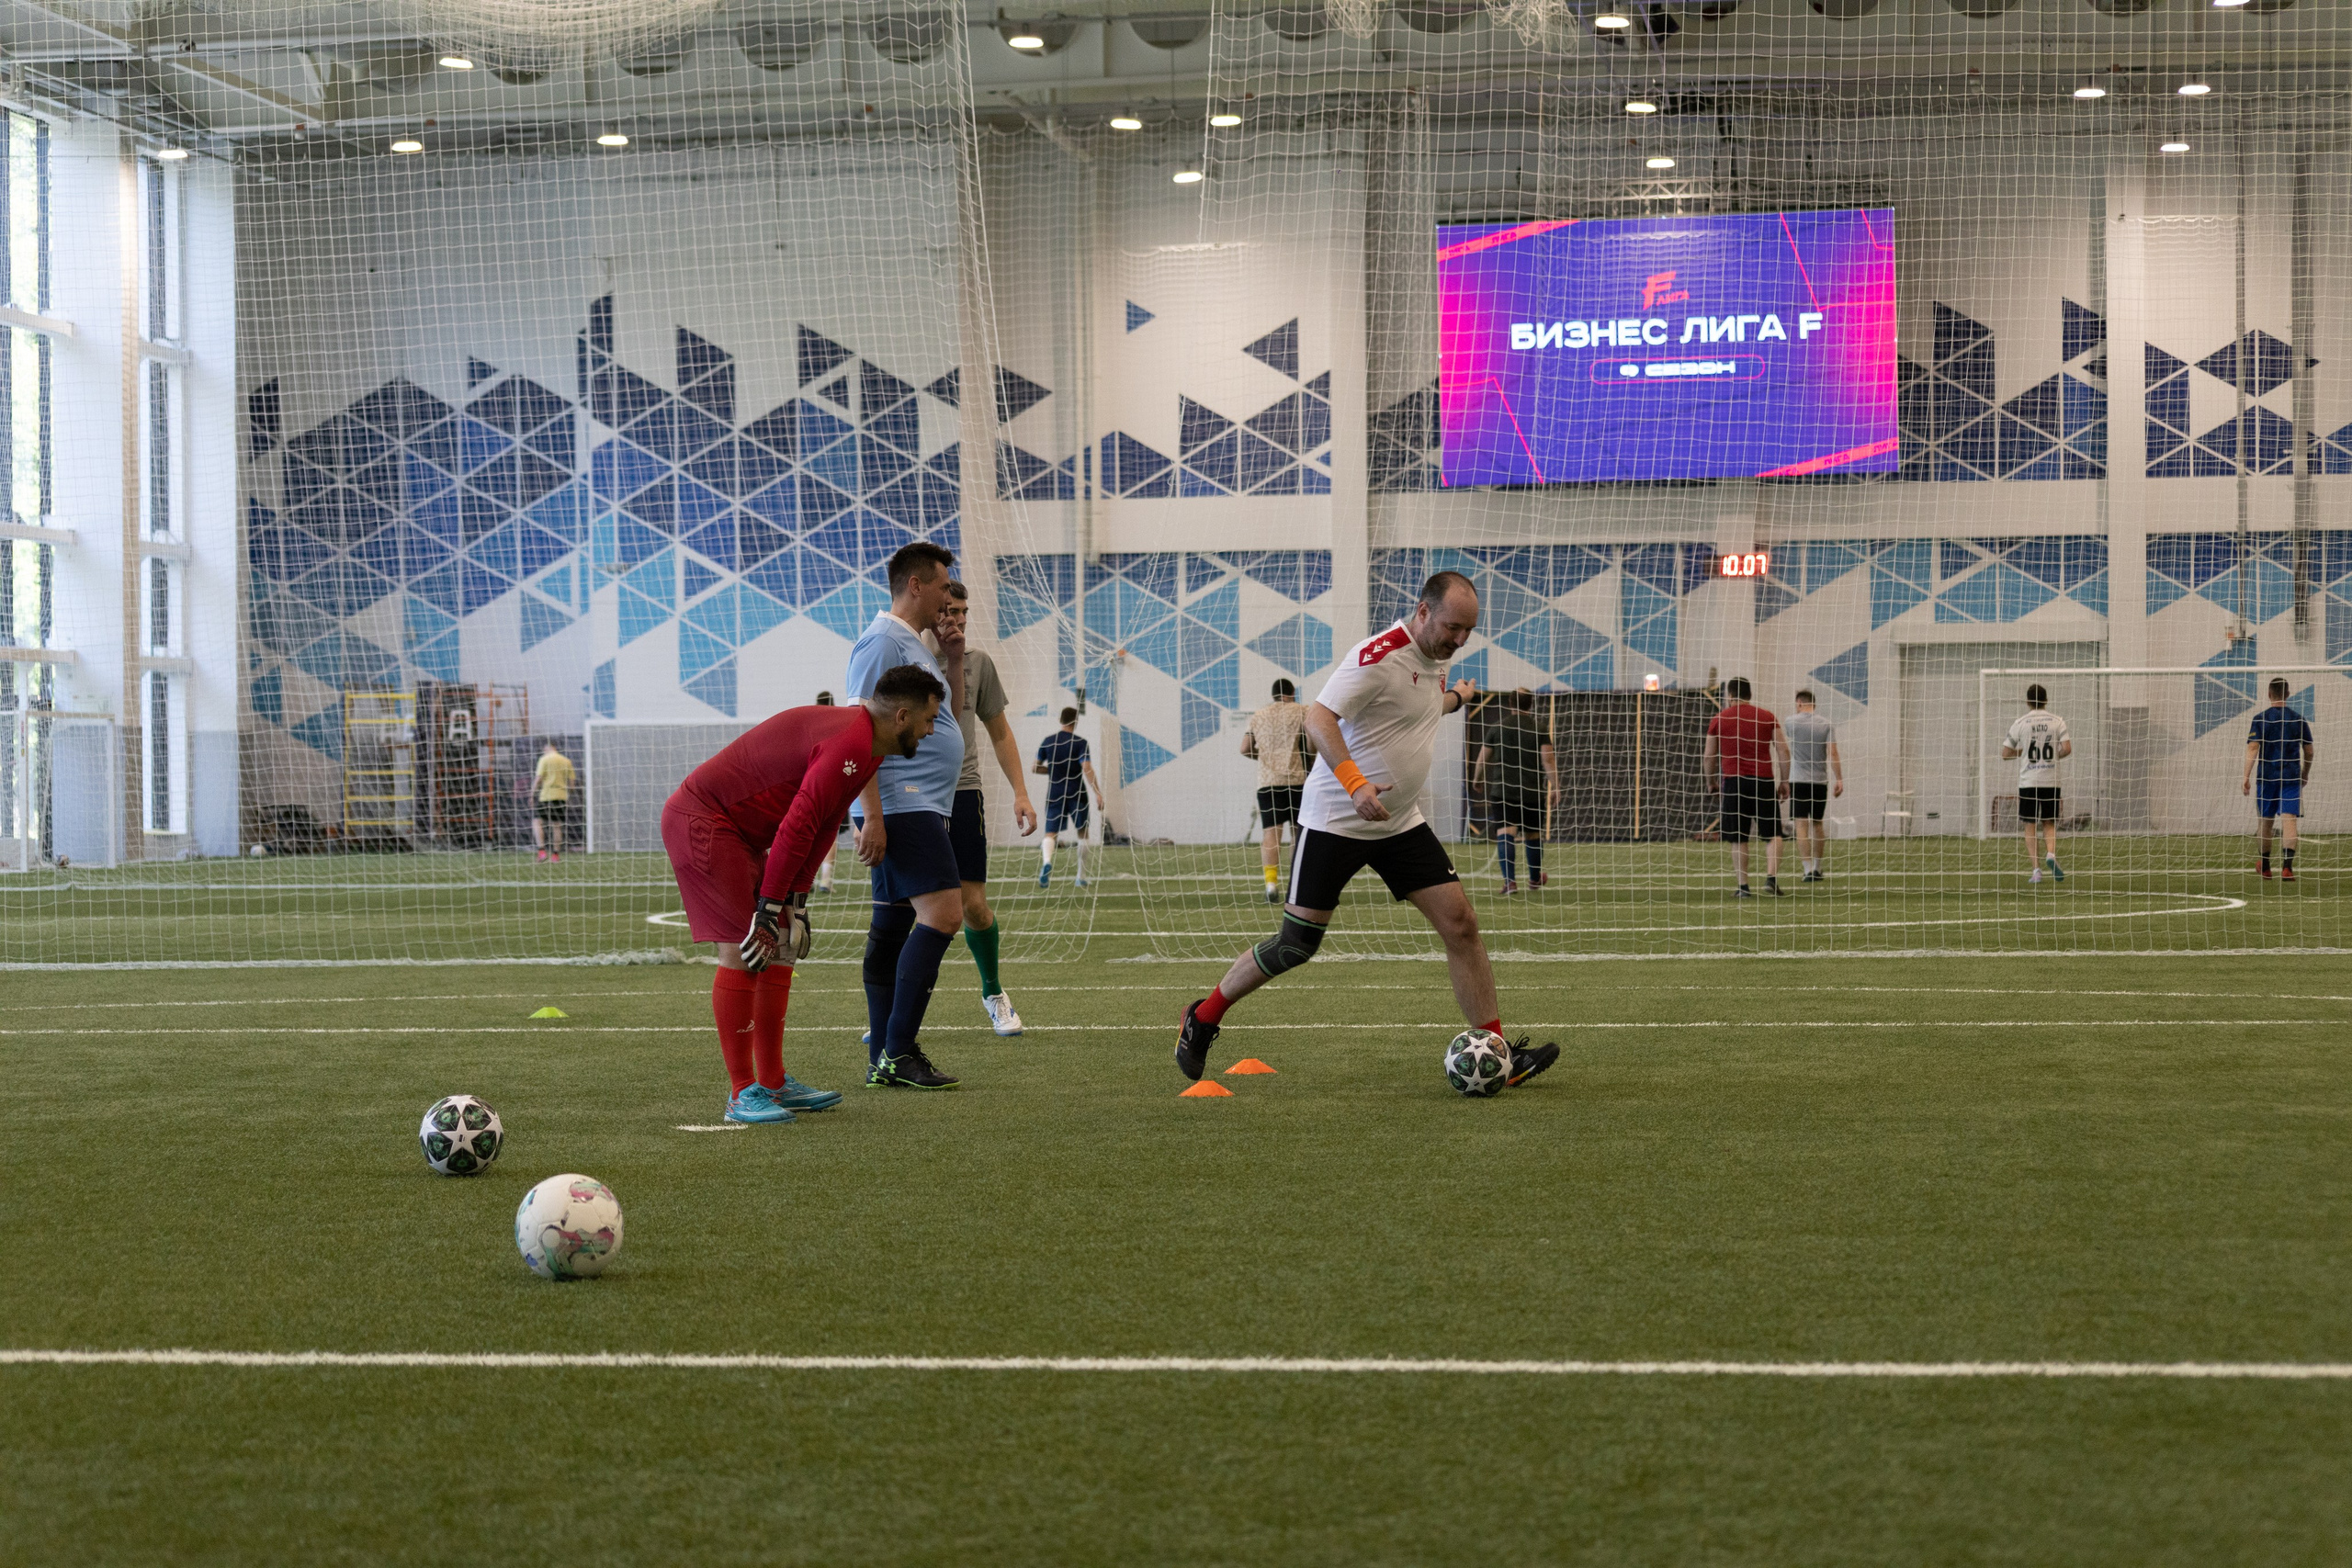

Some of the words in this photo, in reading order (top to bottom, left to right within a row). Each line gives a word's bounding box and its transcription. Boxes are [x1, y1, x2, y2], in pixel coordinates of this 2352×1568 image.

[1510, 318, 1668, 350] БИЗНЕС
[1679, 313, 1787, 344] ЛИГА
[1798, 312, 1823, 340] F
[1644, 360, 1736, 377] СЕЗОН
[2028, 735, 2053, 763] 66
